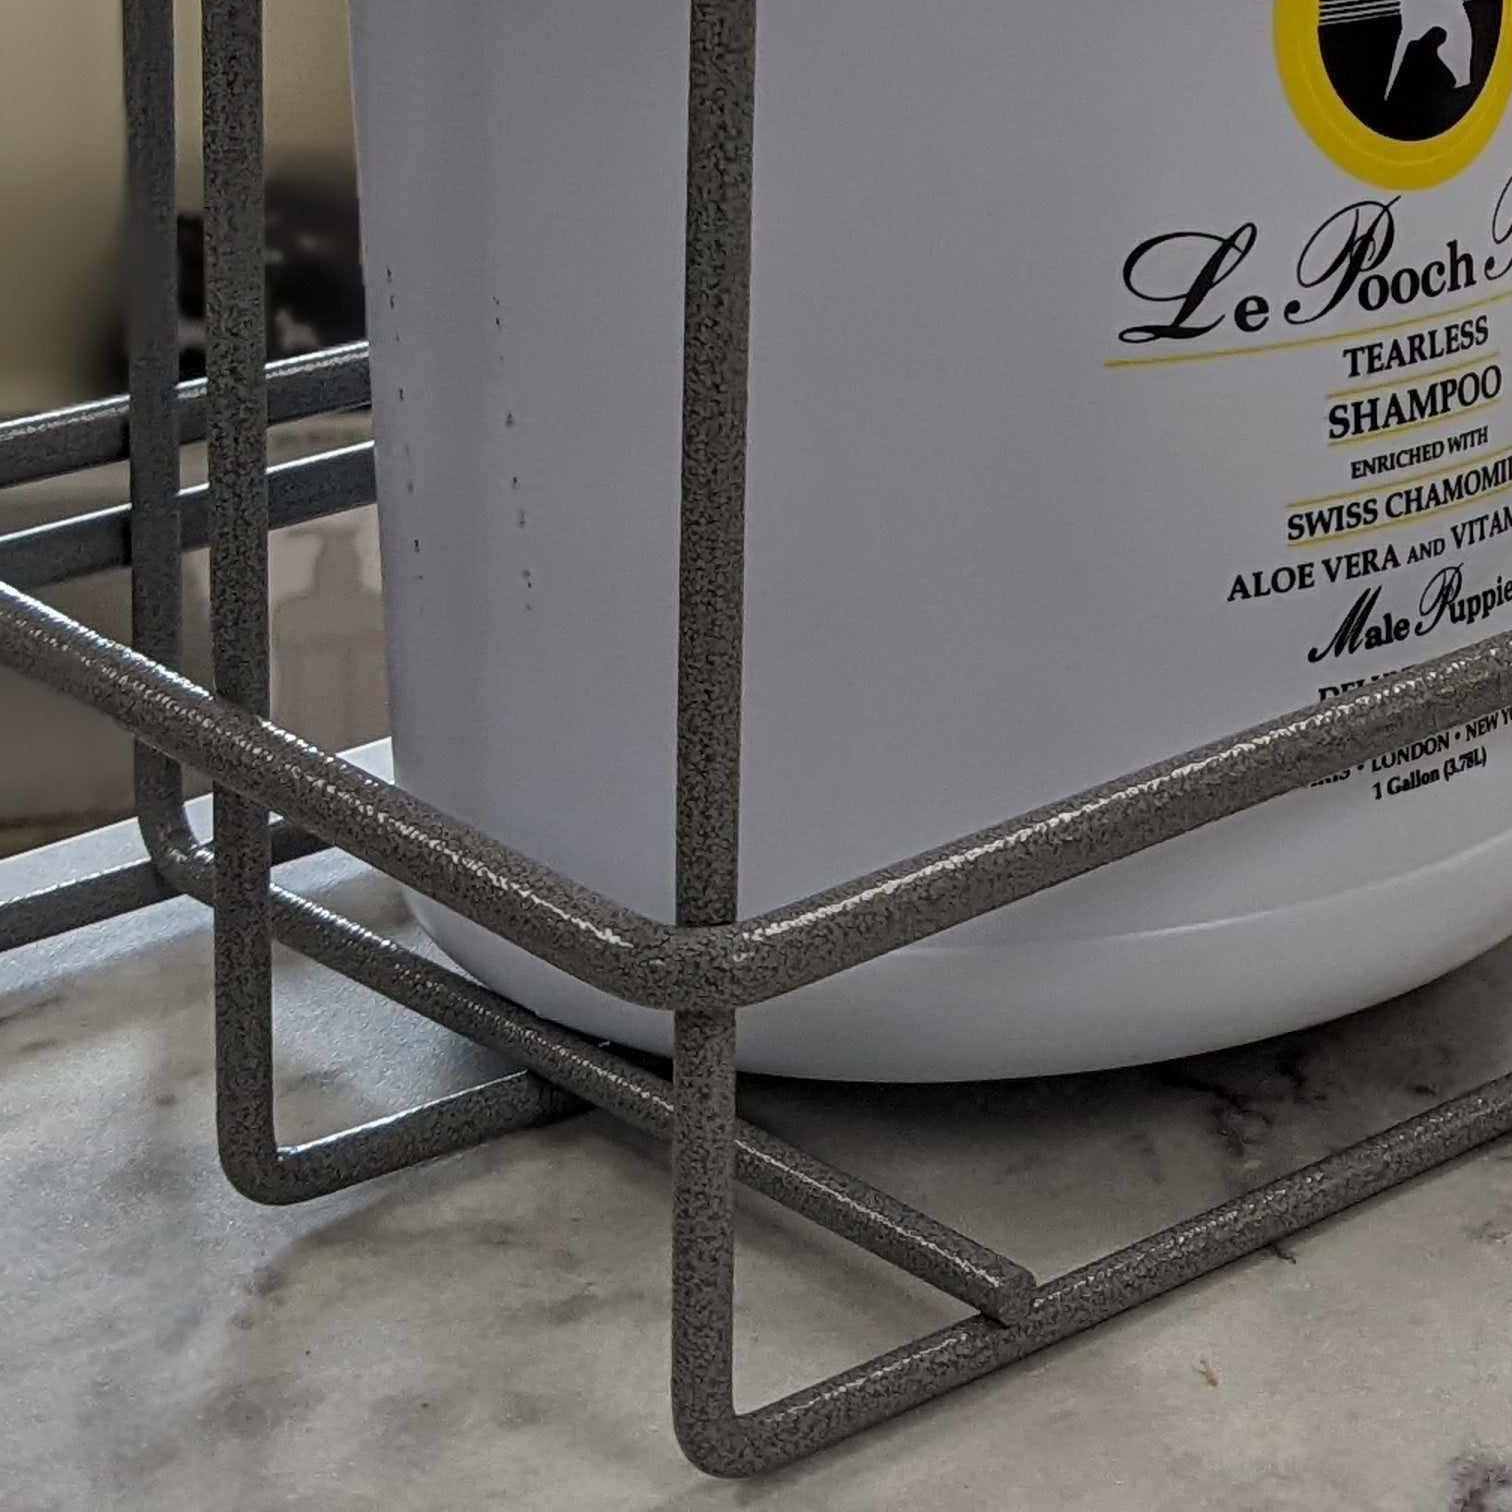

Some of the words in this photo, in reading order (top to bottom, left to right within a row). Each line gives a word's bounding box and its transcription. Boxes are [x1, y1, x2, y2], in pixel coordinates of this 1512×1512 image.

[1118, 223, 1269, 344] Le
[1284, 195, 1477, 325] Pooch
[1343, 315, 1490, 379] TEARLESS
[1328, 365, 1502, 440] SHAMPOO
[1351, 439, 1445, 480] ENRICHED
[1448, 426, 1489, 455] WITH
[1287, 498, 1379, 541] SWISS
[1227, 563, 1316, 602] ALOE
[1322, 544, 1401, 585] VERA
[1407, 538, 1446, 565] AND
[1307, 584, 1411, 663] Male
[1371, 732, 1451, 773] LONDON
[1465, 710, 1500, 742] NEW
[1371, 781, 1383, 801] 1
[1386, 767, 1440, 796] Gallon
